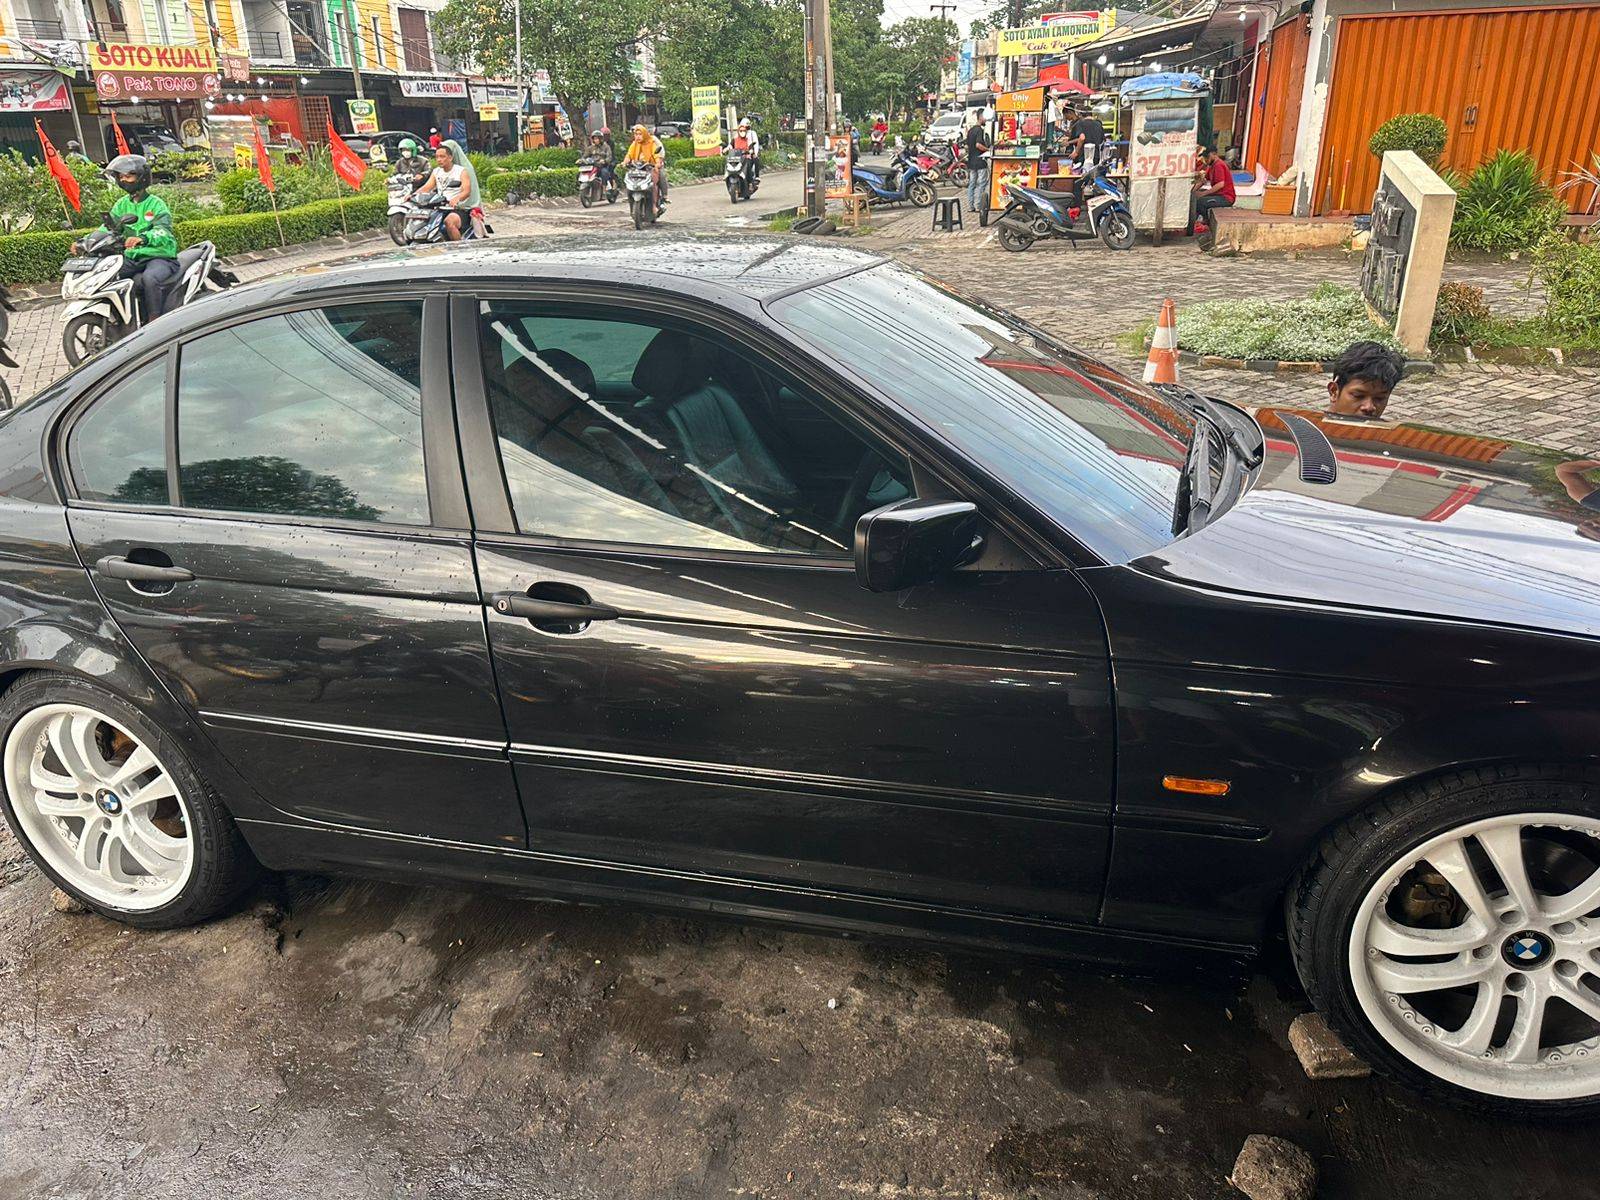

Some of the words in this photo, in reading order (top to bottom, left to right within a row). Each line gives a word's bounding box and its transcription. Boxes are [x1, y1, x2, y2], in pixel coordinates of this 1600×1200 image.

[1003, 30, 1025, 42] SOTO
[1028, 27, 1050, 40] AYAM
[1052, 23, 1100, 37] LAMONGAN
[96, 44, 152, 67] SOTO
[156, 47, 213, 68] KUALI
[123, 76, 153, 92] Pak
[154, 77, 197, 91] TONO
[416, 83, 441, 93] APOTEK
[442, 83, 463, 93] SEHATI
[1011, 94, 1030, 102] Only
